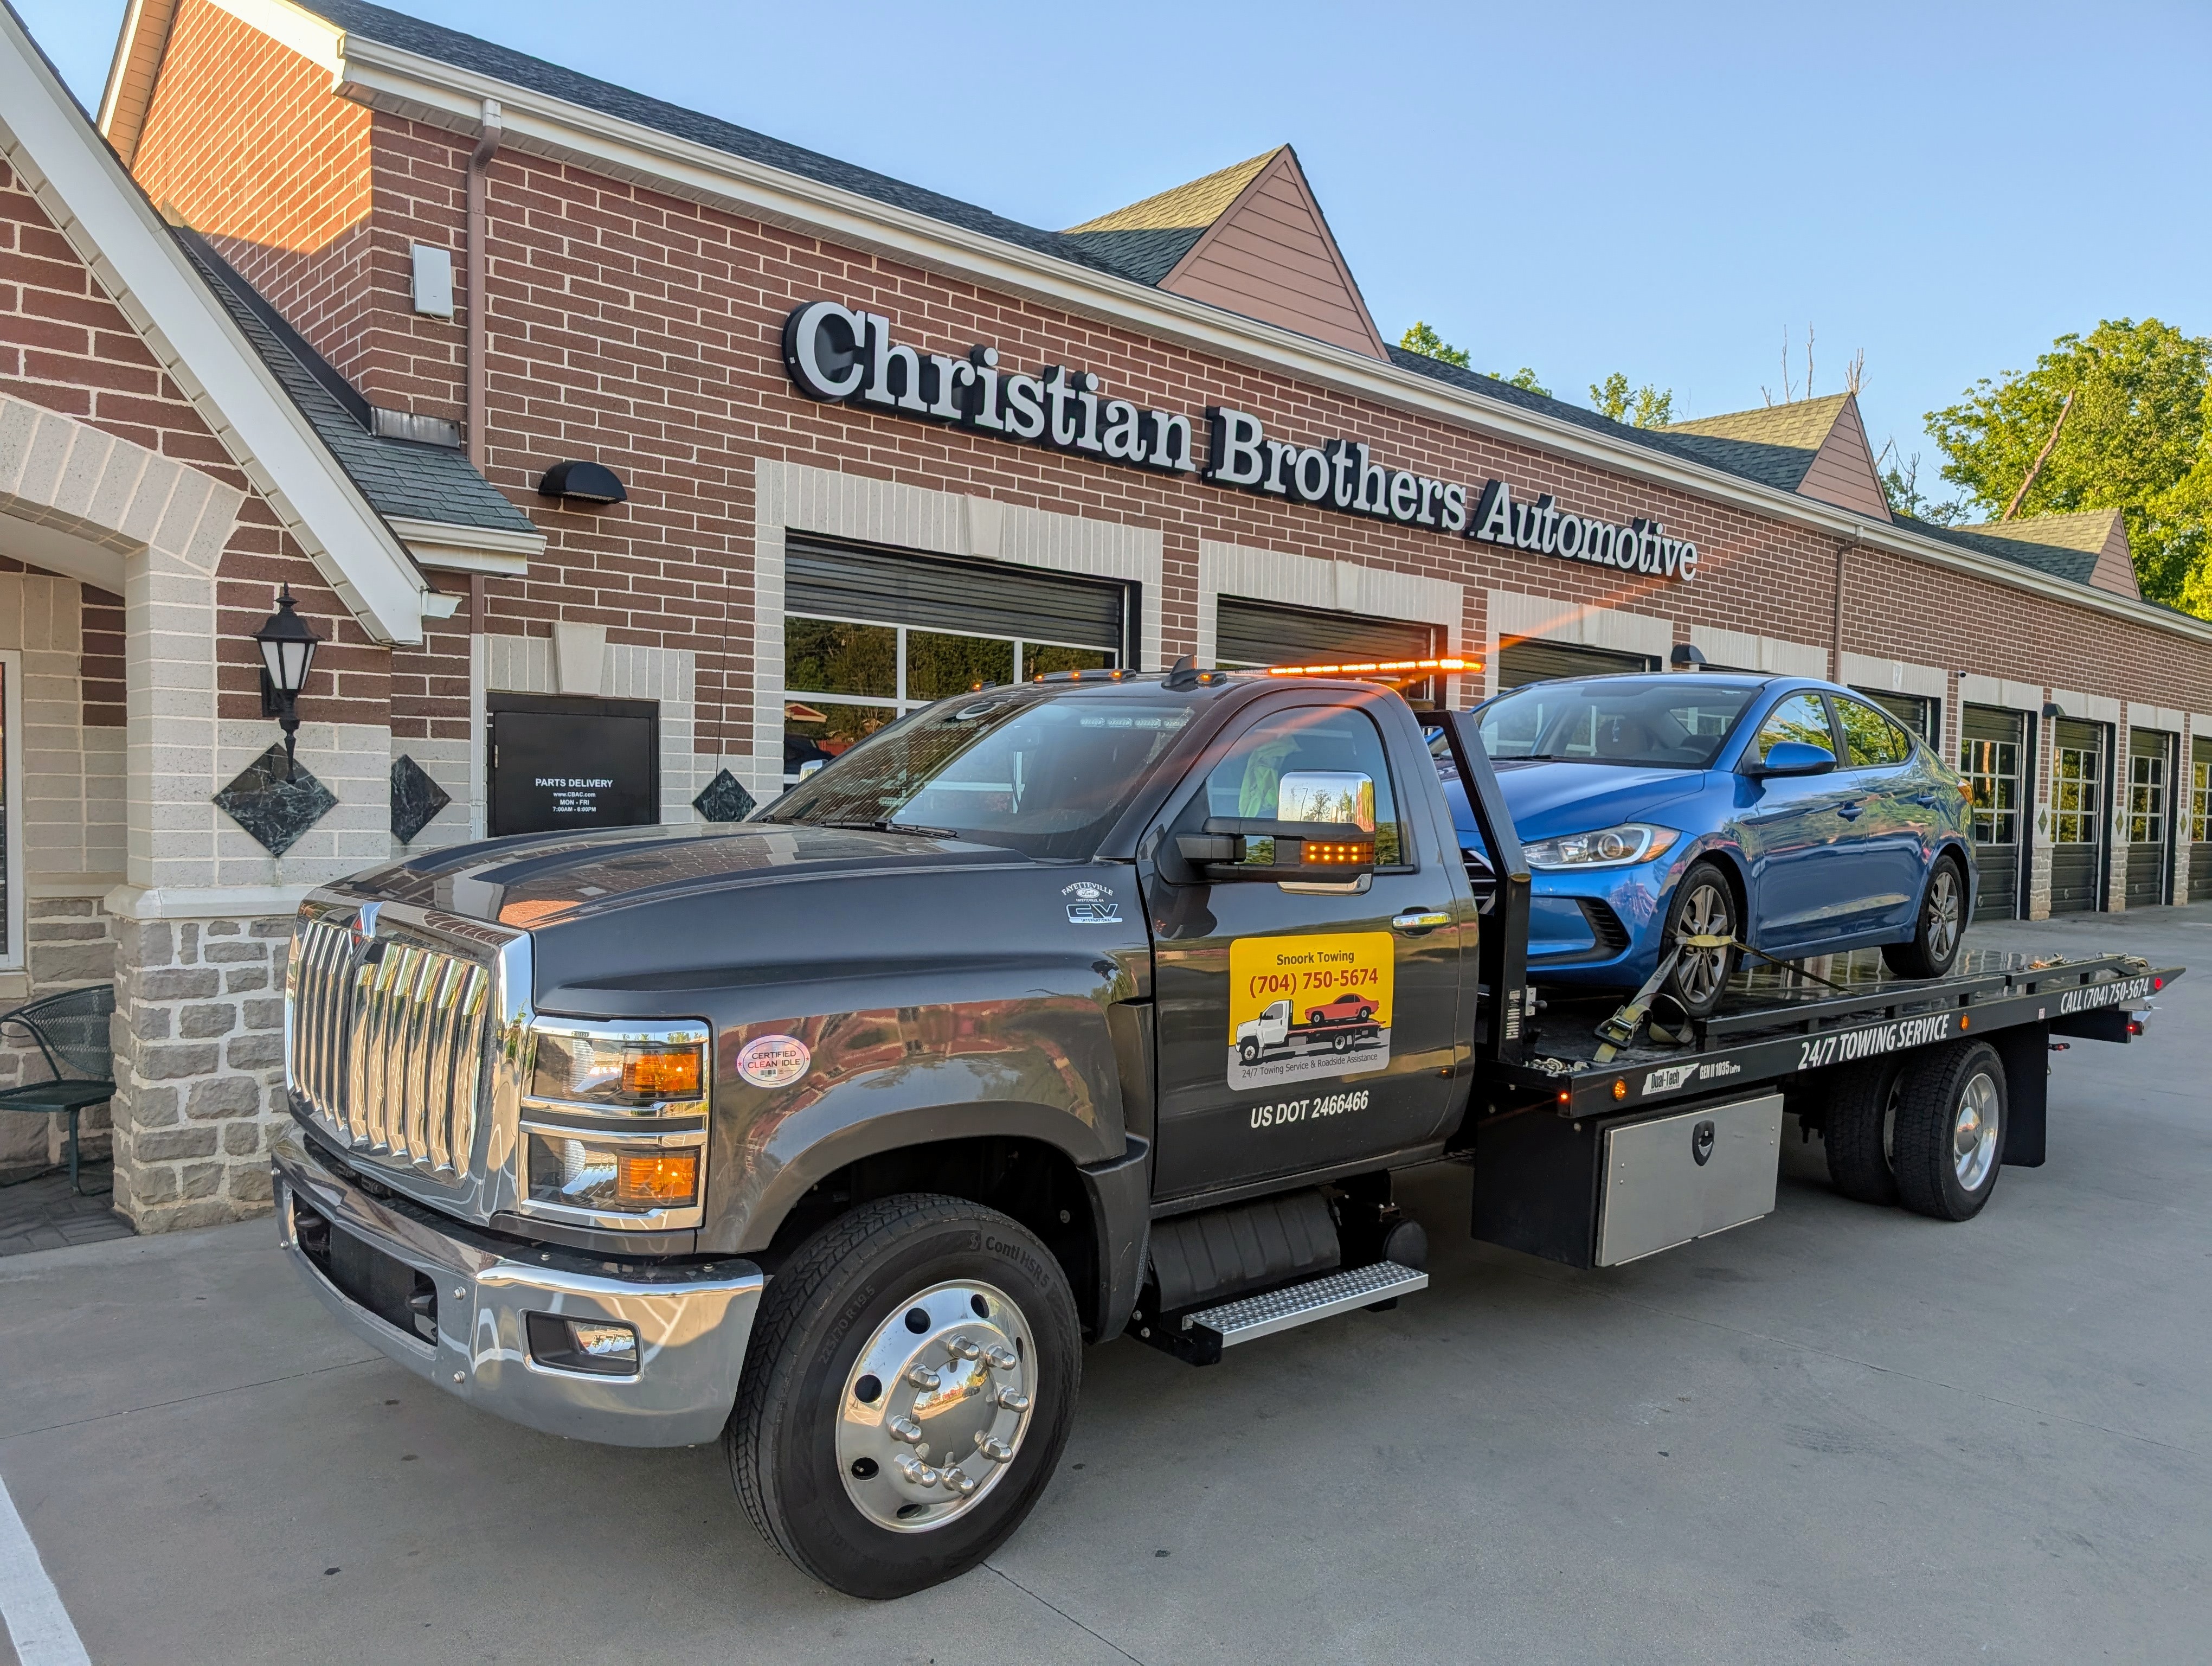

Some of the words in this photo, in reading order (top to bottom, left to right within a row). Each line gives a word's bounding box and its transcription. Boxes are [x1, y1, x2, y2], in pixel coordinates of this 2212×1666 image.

[794, 301, 1196, 472] Christian
[1213, 406, 1467, 531] Brothers
[1477, 481, 1699, 582] Automotive
[535, 778, 566, 787] PARTS
[568, 779, 613, 788] DELIVERY
[1061, 882, 1114, 896] FAYETTEVILLE
[1276, 953, 1315, 966] Snoork
[1317, 950, 1354, 965] Towing
[1250, 972, 1297, 998] (704)
[1303, 968, 1378, 990] 750-5674
[2060, 989, 2082, 1014] CALL
[2084, 985, 2108, 1009] (704)
[2108, 977, 2150, 1003] 750-5674
[1797, 1036, 1837, 1071] 24/7
[1838, 1024, 1897, 1061] TOWING
[1897, 1014, 1950, 1048] SERVICE
[748, 1060, 777, 1068] CLEAN
[751, 1050, 796, 1060] CERTIFIED
[1242, 1067, 1258, 1079] 24/7
[1260, 1064, 1284, 1077] Towing
[1285, 1061, 1309, 1072] Service
[1310, 1060, 1316, 1068] &
[1317, 1055, 1345, 1067] Roadside
[1346, 1053, 1378, 1064] Assistance
[1699, 1064, 1711, 1080] GEN
[1715, 1060, 1730, 1077] 1035
[1650, 1068, 1680, 1089] Dual-Tech
[1250, 1105, 1272, 1129] US
[1275, 1100, 1309, 1125] DOT
[1311, 1090, 1369, 1119] 2466466
